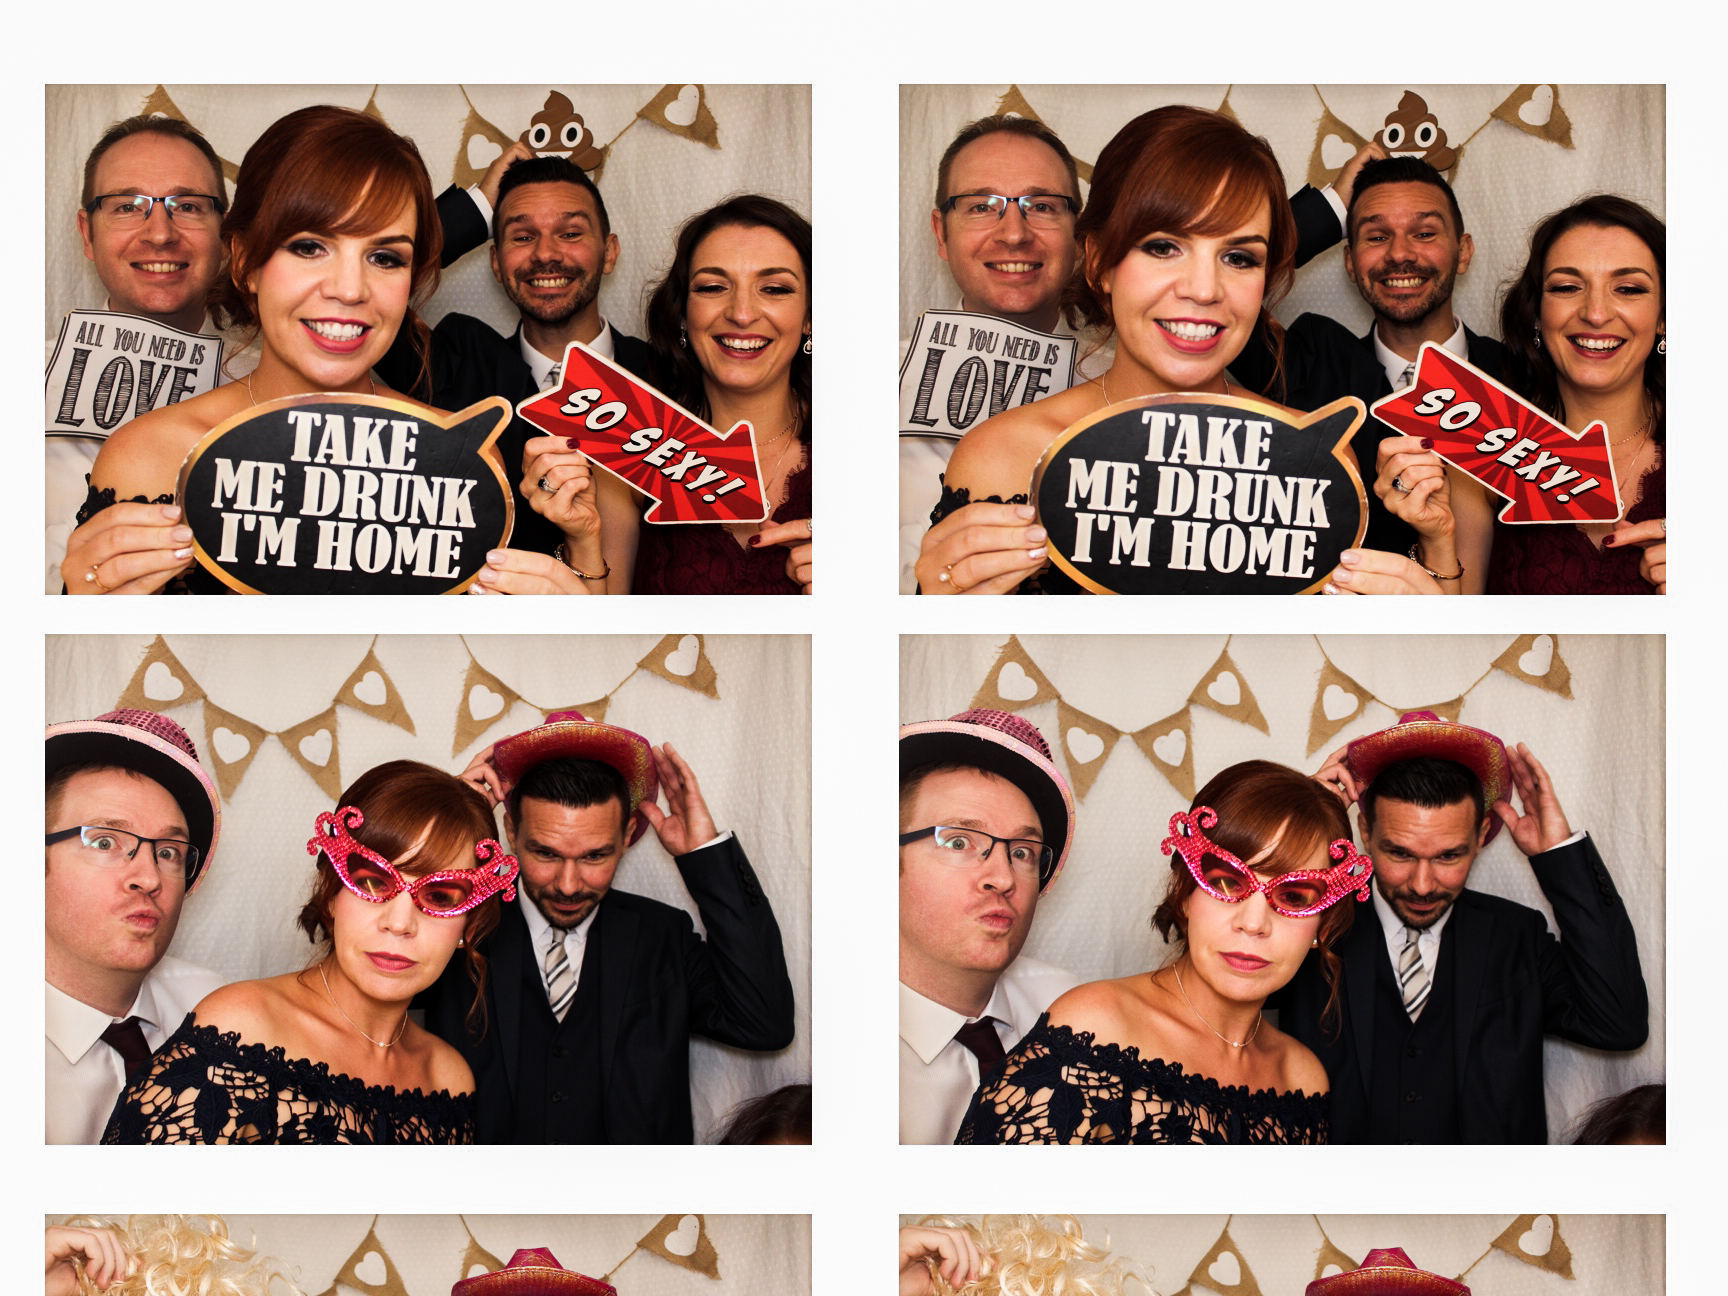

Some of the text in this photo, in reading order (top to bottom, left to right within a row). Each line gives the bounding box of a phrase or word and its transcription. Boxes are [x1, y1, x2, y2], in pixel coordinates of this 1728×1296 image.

[75, 320, 206, 366] ALL YOU NEED IS
[929, 320, 1060, 366] ALL YOU NEED IS
[55, 347, 198, 430] LOVE
[909, 347, 1052, 430] LOVE
[288, 410, 419, 471] TAKE
[560, 388, 747, 504] SO SEXY!
[1142, 410, 1273, 471] TAKE
[1414, 388, 1601, 504] SO SEXY!
[211, 457, 478, 528] ME DRUNK
[1065, 457, 1332, 528] ME DRUNK
[217, 512, 463, 578] I'M HOME
[1071, 512, 1317, 578] I'M HOME
